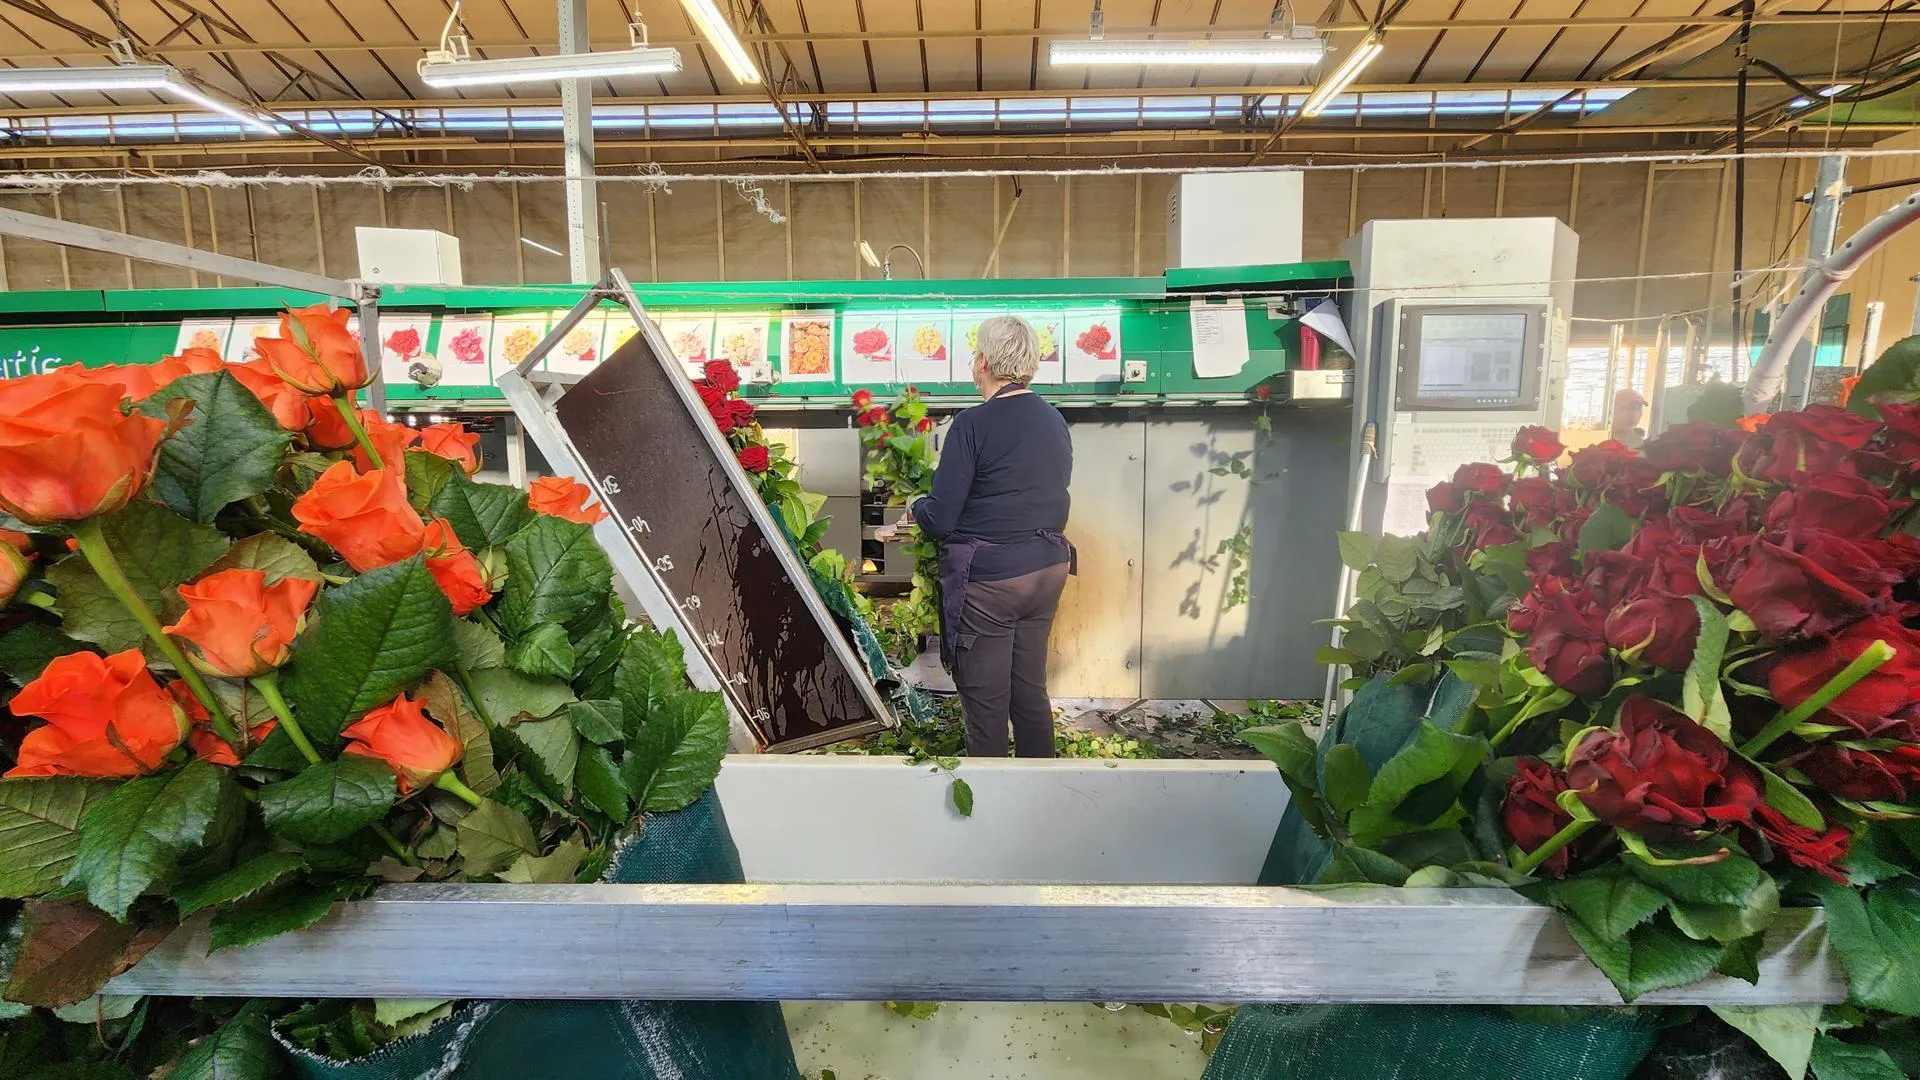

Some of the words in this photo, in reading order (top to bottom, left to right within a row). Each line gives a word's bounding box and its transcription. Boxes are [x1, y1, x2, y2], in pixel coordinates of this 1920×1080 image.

[602, 474, 621, 495] 30
[631, 516, 652, 533] 40
[656, 554, 675, 571] 50
[685, 594, 700, 610] 60
[707, 630, 724, 646] 70
[733, 671, 748, 685] 80
[757, 707, 771, 721] 90
